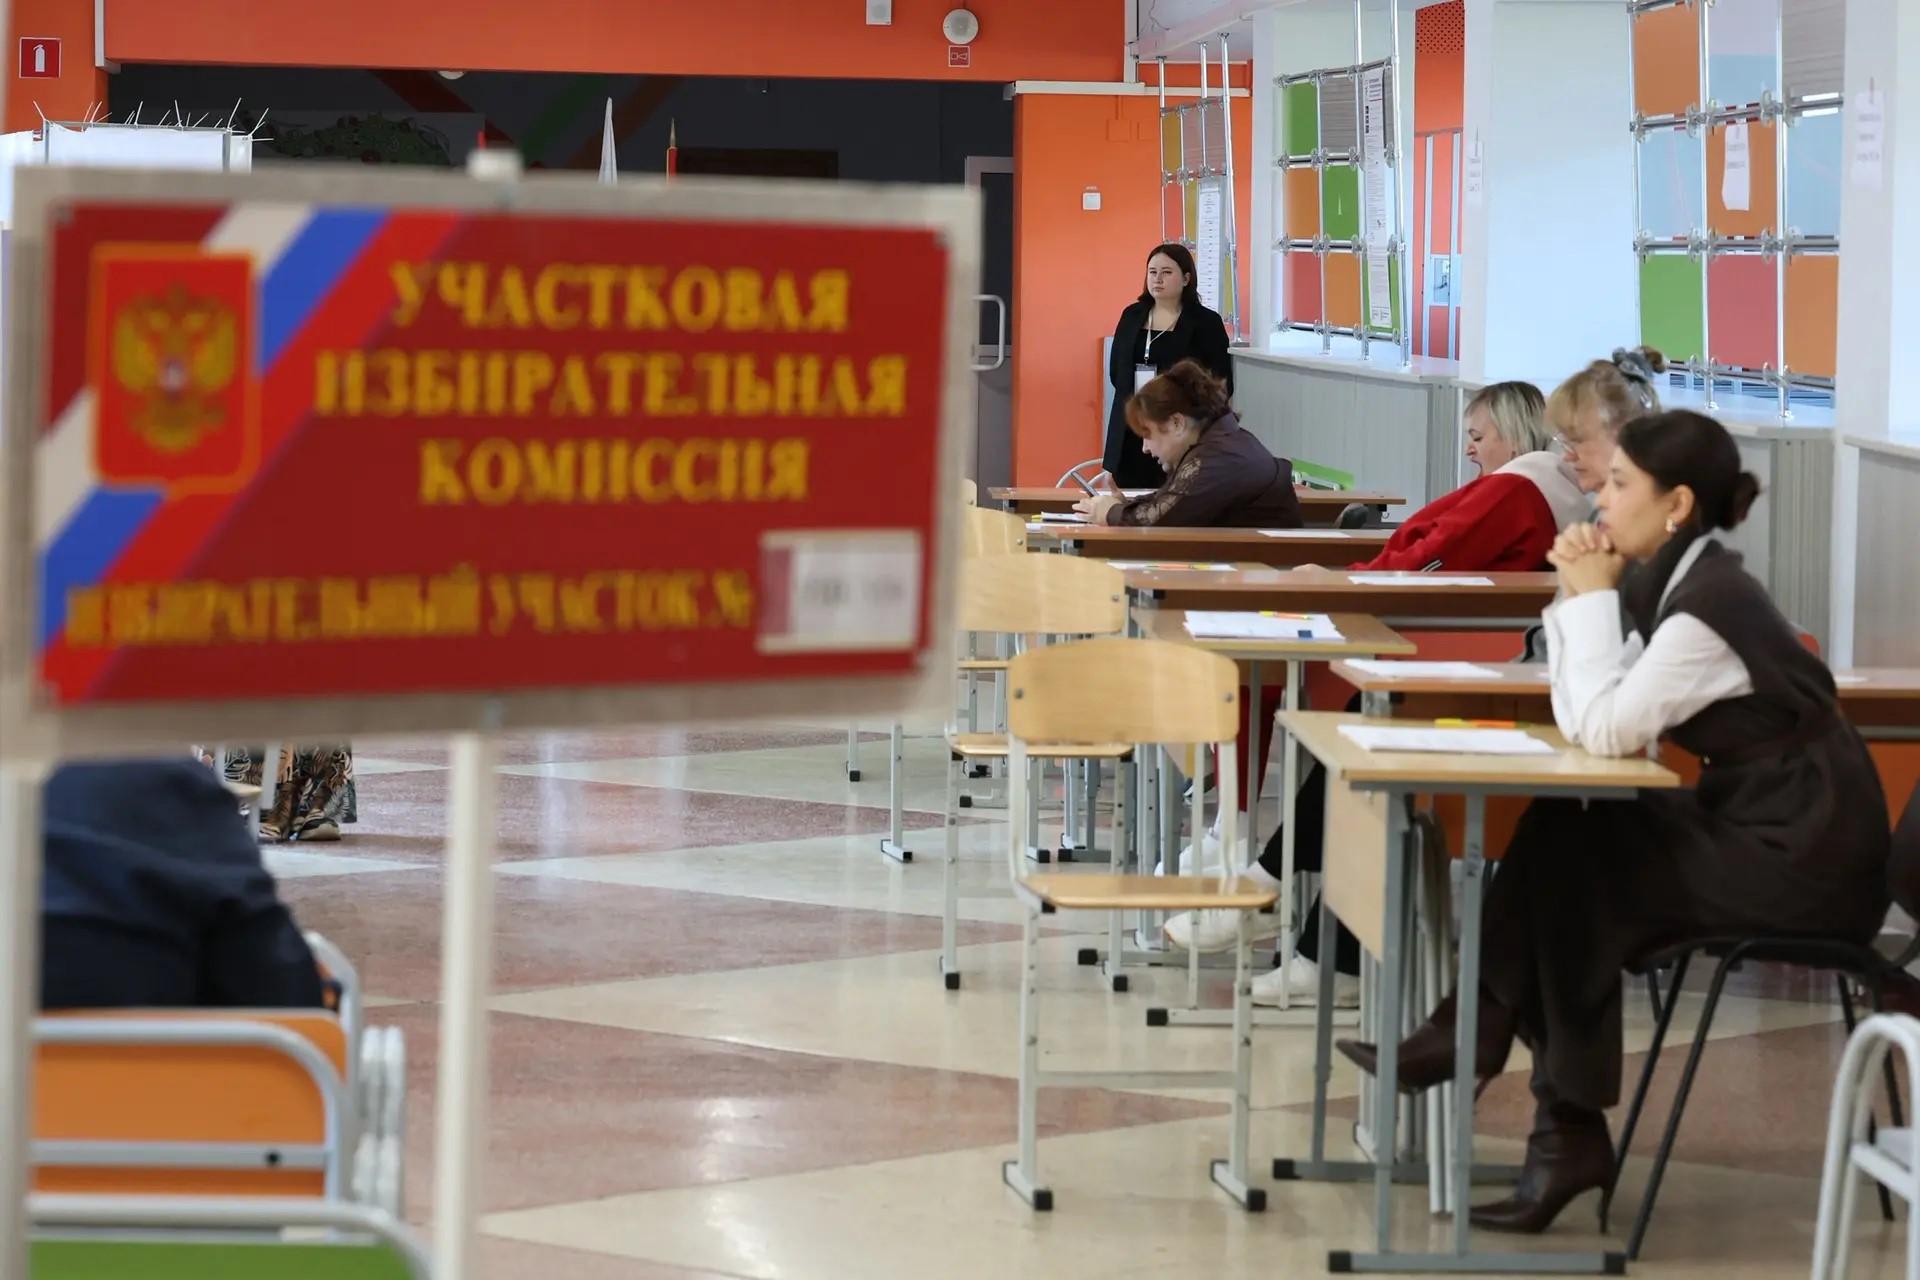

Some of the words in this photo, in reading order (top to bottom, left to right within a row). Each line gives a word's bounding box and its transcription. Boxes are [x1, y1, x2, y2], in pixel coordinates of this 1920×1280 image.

[389, 260, 849, 332] УЧАСТКОВАЯ
[314, 349, 907, 416] ИЗБИРАТЕЛЬНАЯ
[419, 437, 809, 503] КОМИССИЯ
